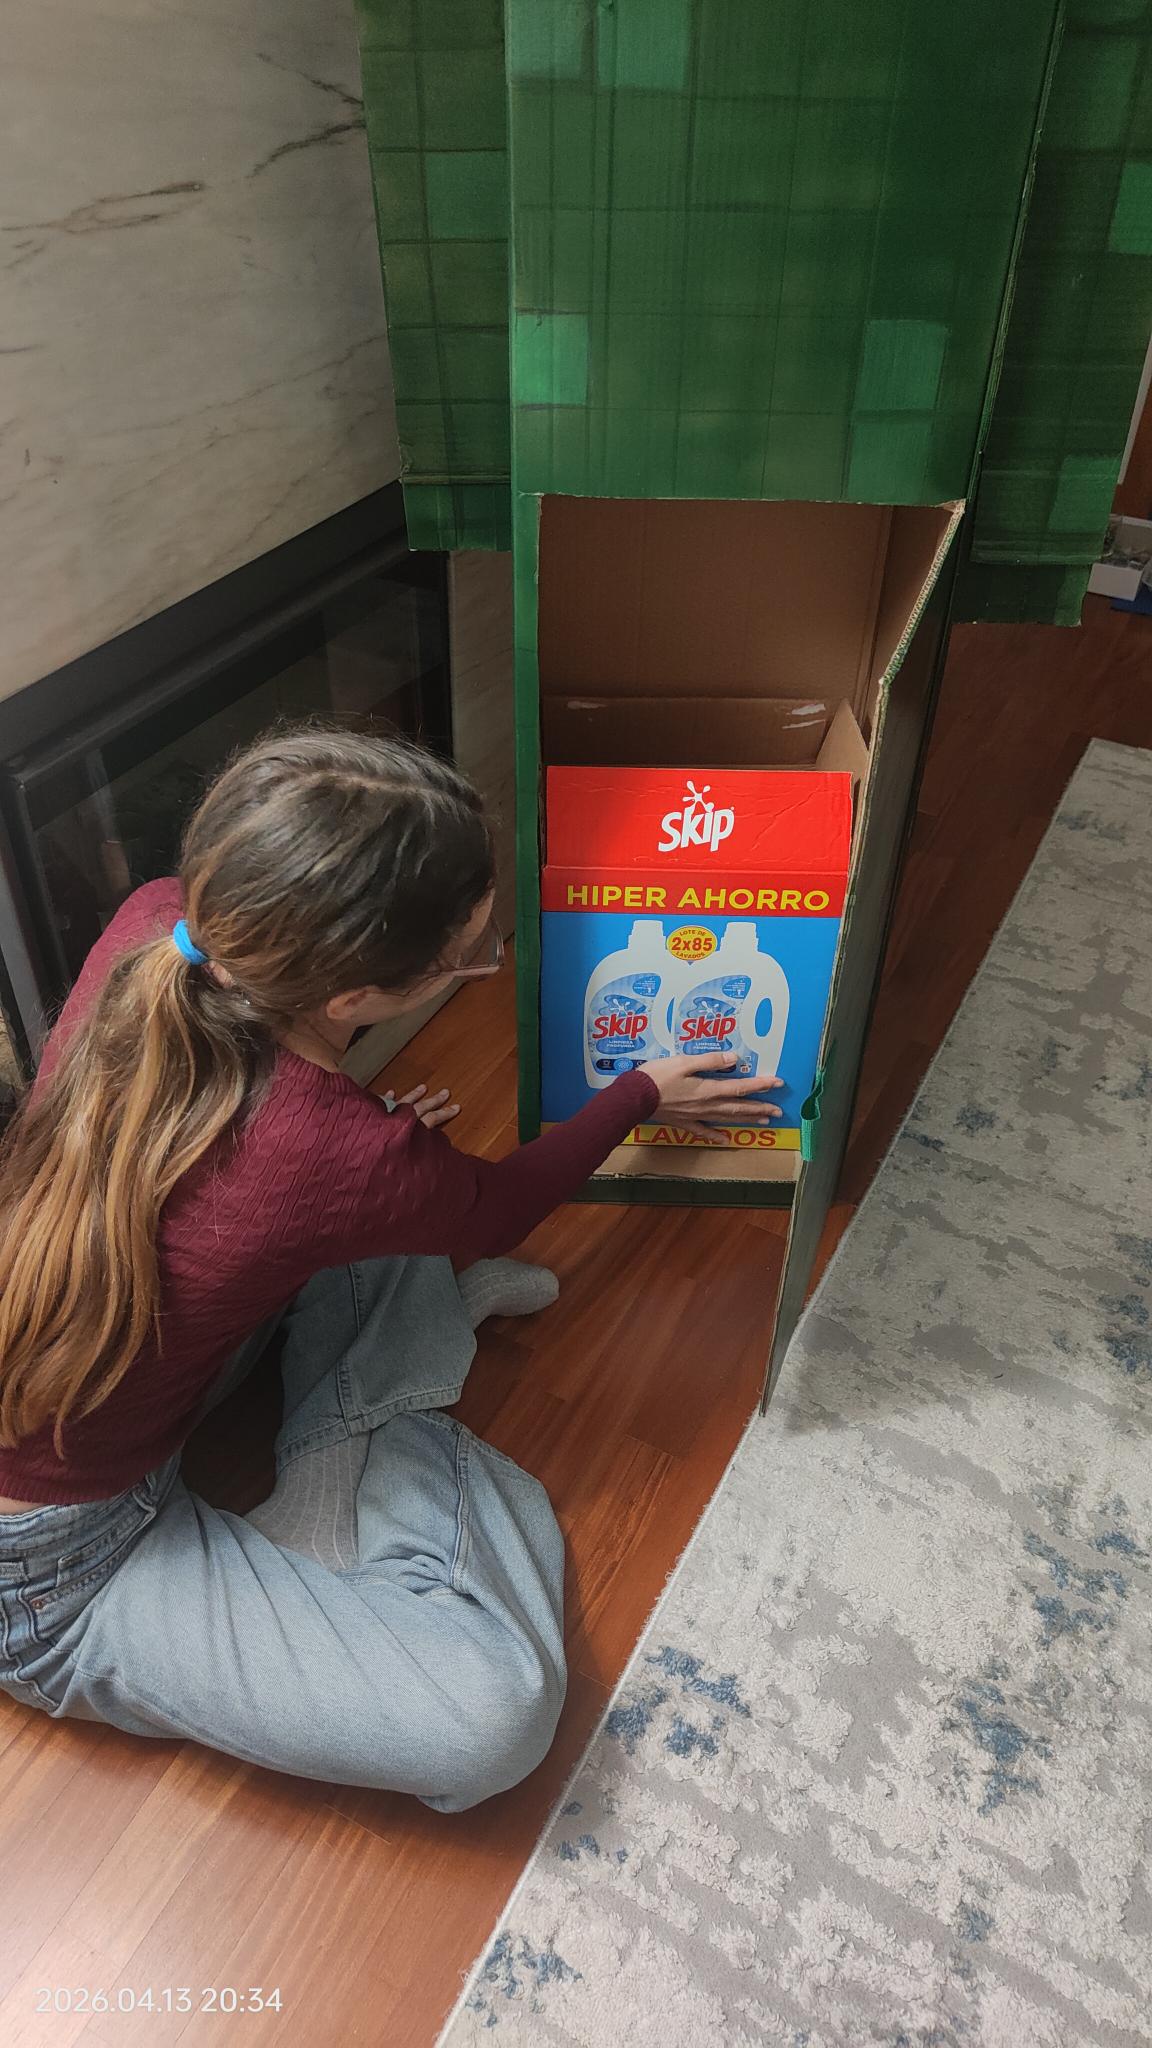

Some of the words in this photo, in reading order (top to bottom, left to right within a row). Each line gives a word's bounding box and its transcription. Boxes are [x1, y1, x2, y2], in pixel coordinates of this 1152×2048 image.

[658, 803, 735, 852] Skip
[567, 884, 667, 908] HIPER
[677, 887, 830, 911] AHORRO
[671, 936, 713, 952] 2x85
[675, 950, 706, 959] LAVADOS
[592, 1011, 648, 1040] Skip
[679, 1013, 737, 1042] Skip
